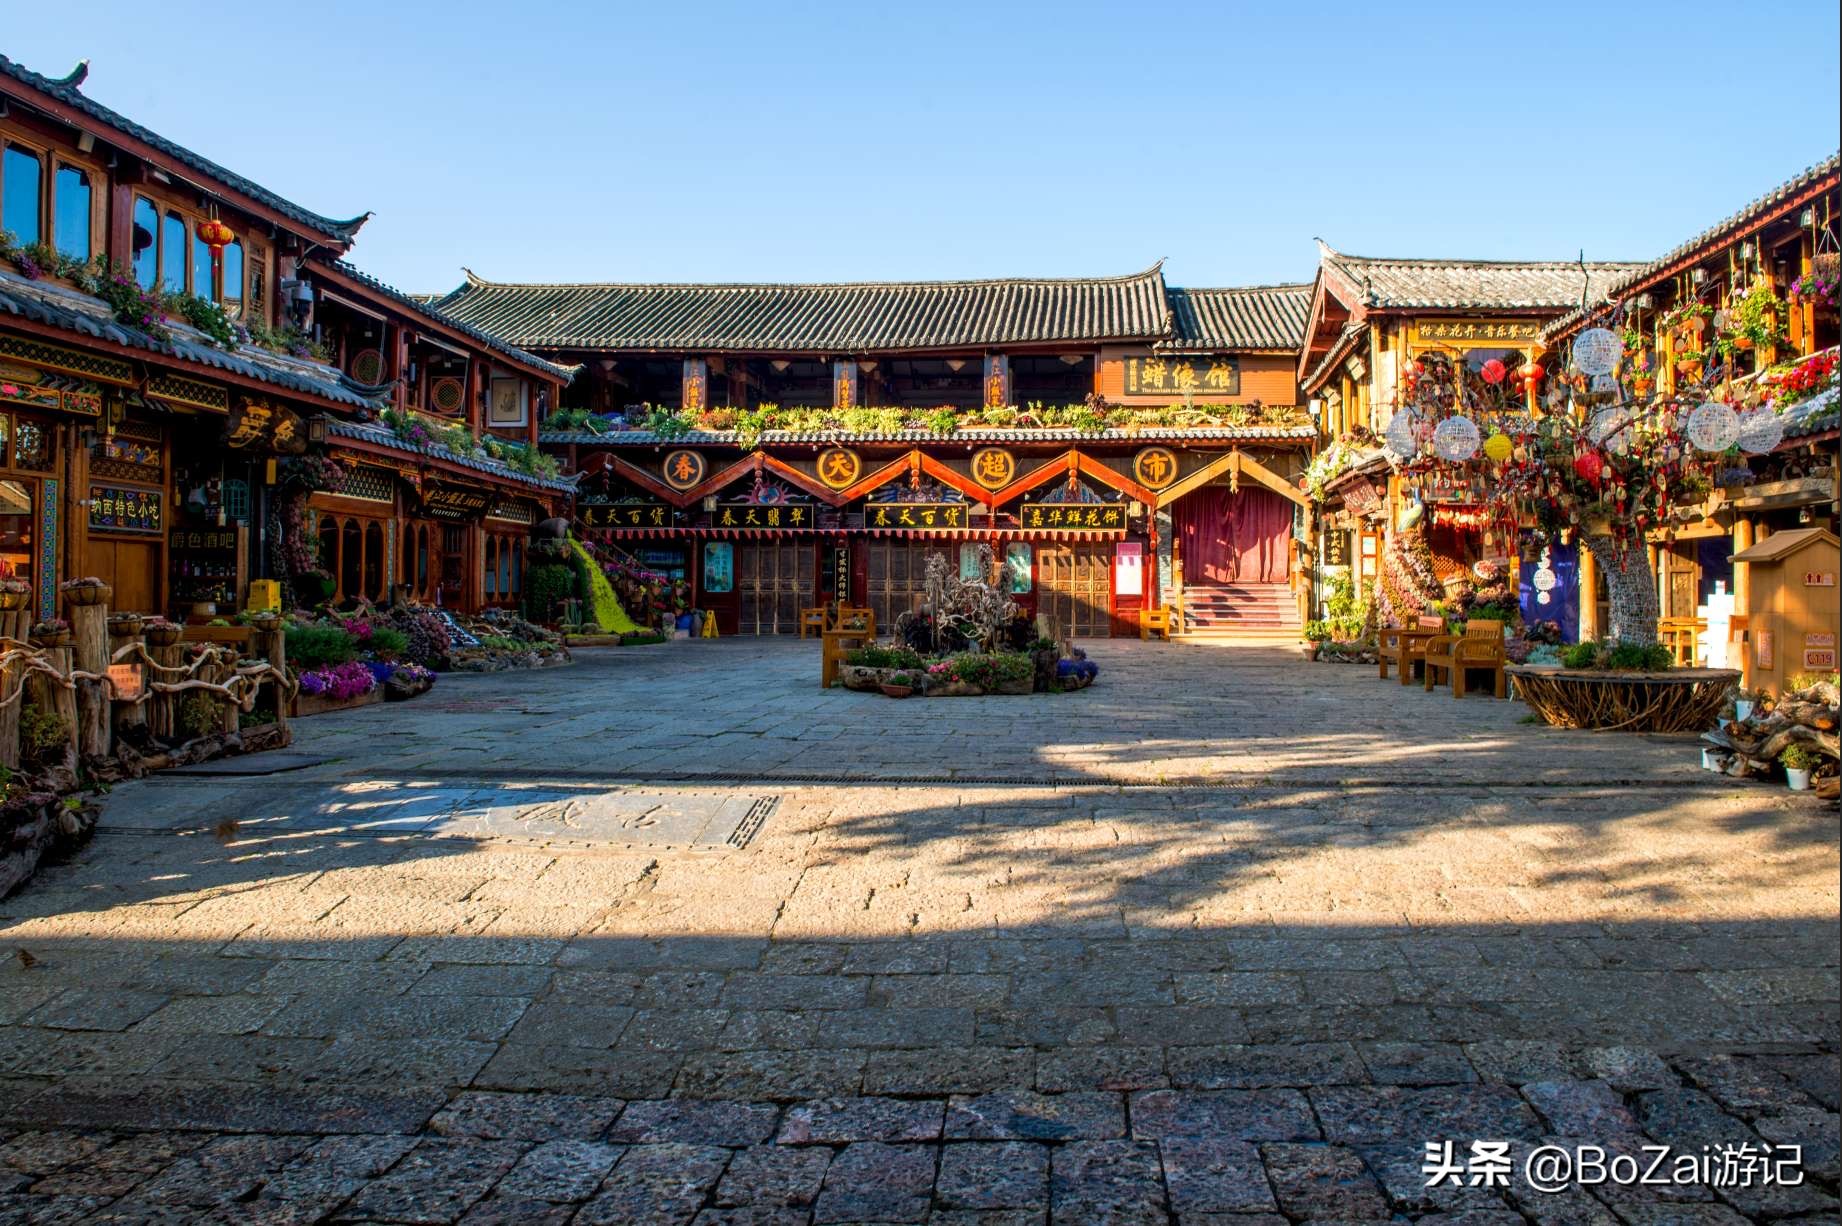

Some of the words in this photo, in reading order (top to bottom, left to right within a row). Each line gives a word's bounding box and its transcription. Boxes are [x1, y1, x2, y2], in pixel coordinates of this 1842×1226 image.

[1142, 358, 1232, 388] 蜡像馆
[672, 454, 696, 480] 春
[828, 454, 853, 478] 天
[980, 453, 1007, 478] 超
[1142, 454, 1168, 482] 市
[91, 498, 159, 520] 纳西特色小吃
[583, 507, 665, 526] 春天百货
[873, 508, 961, 527] 春天百货
[1029, 508, 1120, 527] 嘉华鲜花饼
[1815, 654, 1832, 665] 119
